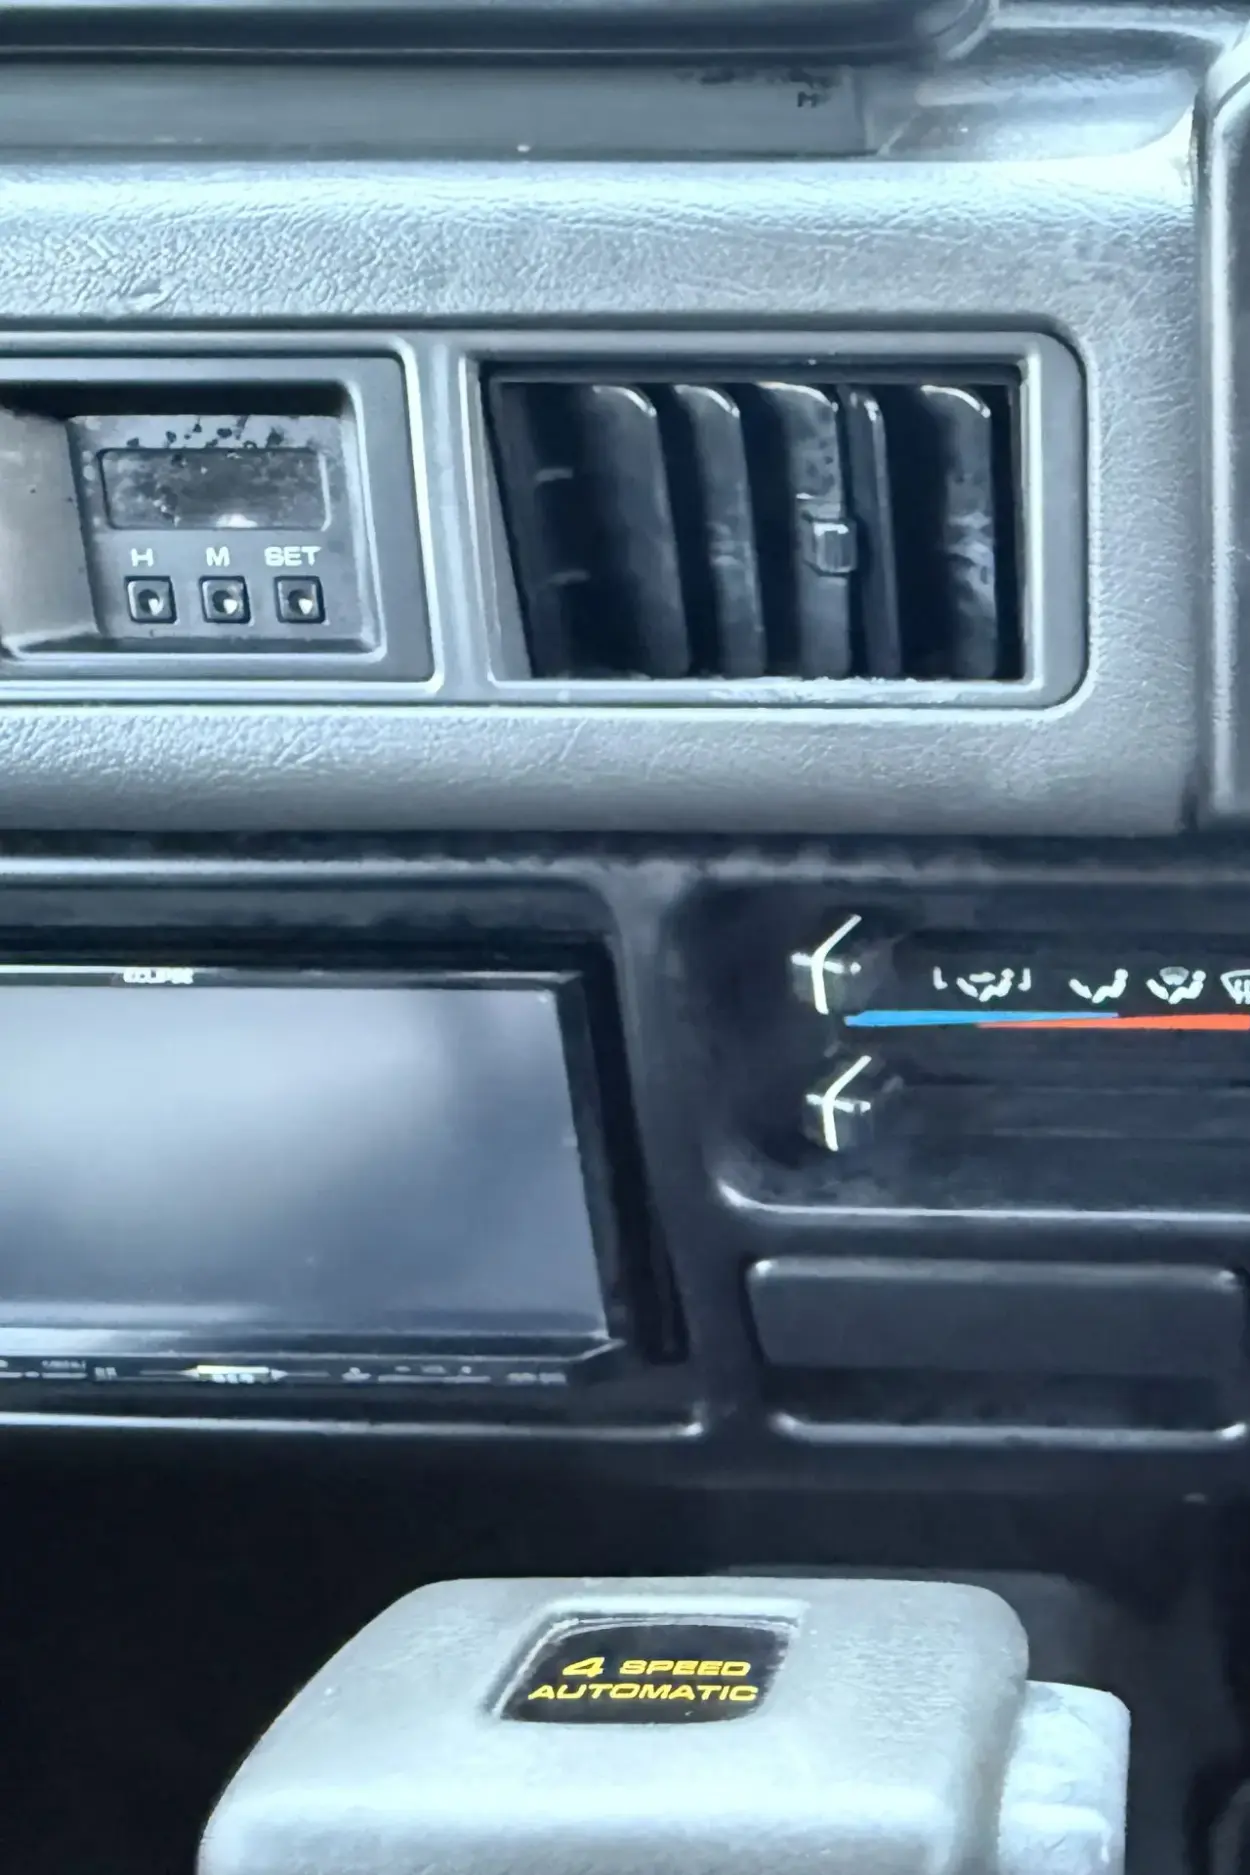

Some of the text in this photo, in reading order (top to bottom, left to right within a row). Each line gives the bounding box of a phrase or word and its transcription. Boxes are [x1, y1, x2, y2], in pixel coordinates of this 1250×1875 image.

[130, 547, 154, 567] H
[205, 546, 230, 567] M
[263, 545, 321, 567] SET
[562, 1656, 752, 1678] 4 SPEED
[527, 1682, 760, 1702] AUTOMATIC
